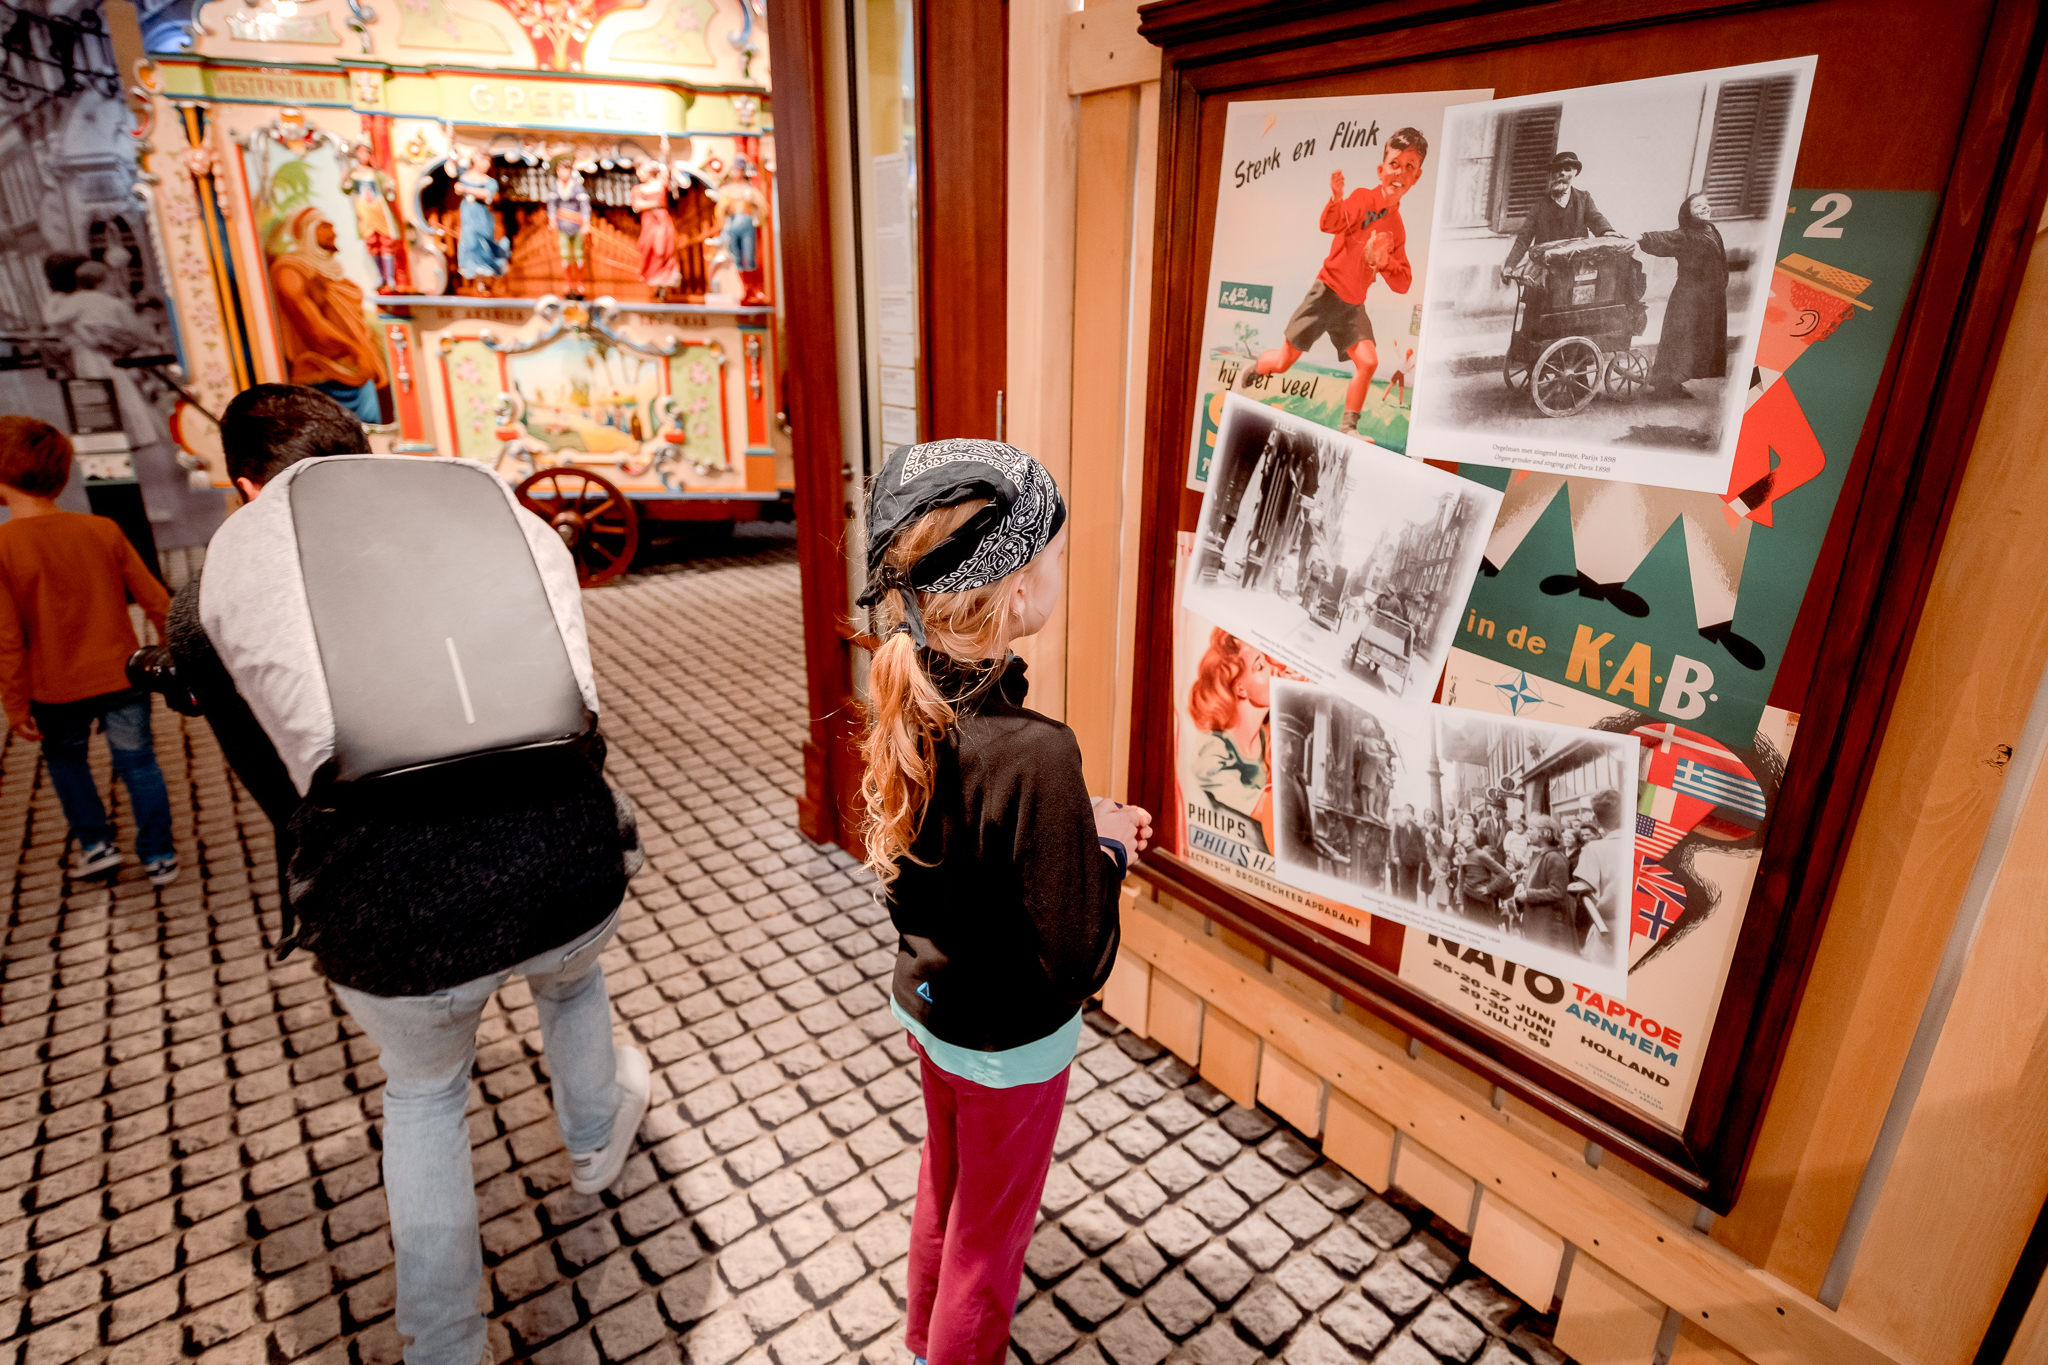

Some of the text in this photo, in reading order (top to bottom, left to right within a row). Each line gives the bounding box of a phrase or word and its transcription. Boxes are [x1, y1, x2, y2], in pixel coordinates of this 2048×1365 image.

[1235, 120, 1380, 188] Sterk en flink
[1802, 192, 1853, 239] 2
[1281, 376, 1319, 399] veel
[1492, 443, 1520, 453] Orgelman
[1534, 448, 1558, 458] zingend
[1558, 451, 1580, 461] meisje,
[1581, 453, 1599, 462] Parijs
[1599, 455, 1617, 463] 1898
[1494, 453, 1511, 462] Organ
[1511, 456, 1532, 464] grinder
[1532, 458, 1544, 466] and
[1544, 460, 1565, 469] singing
[1578, 463, 1594, 472] Paris
[1594, 465, 1611, 473] 1898
[1466, 608, 1496, 640] in
[1506, 625, 1547, 655] de
[1188, 803, 1247, 839] PHILIPS
[1482, 1009, 1518, 1032] JULI
[1513, 1014, 1553, 1039] JUNI
[1515, 1003, 1556, 1028] JUNI
[1572, 983, 1683, 1050] TAPTOE
[1565, 1002, 1679, 1068] ARNHEM
[1580, 1035, 1670, 1087] HOLLAND
